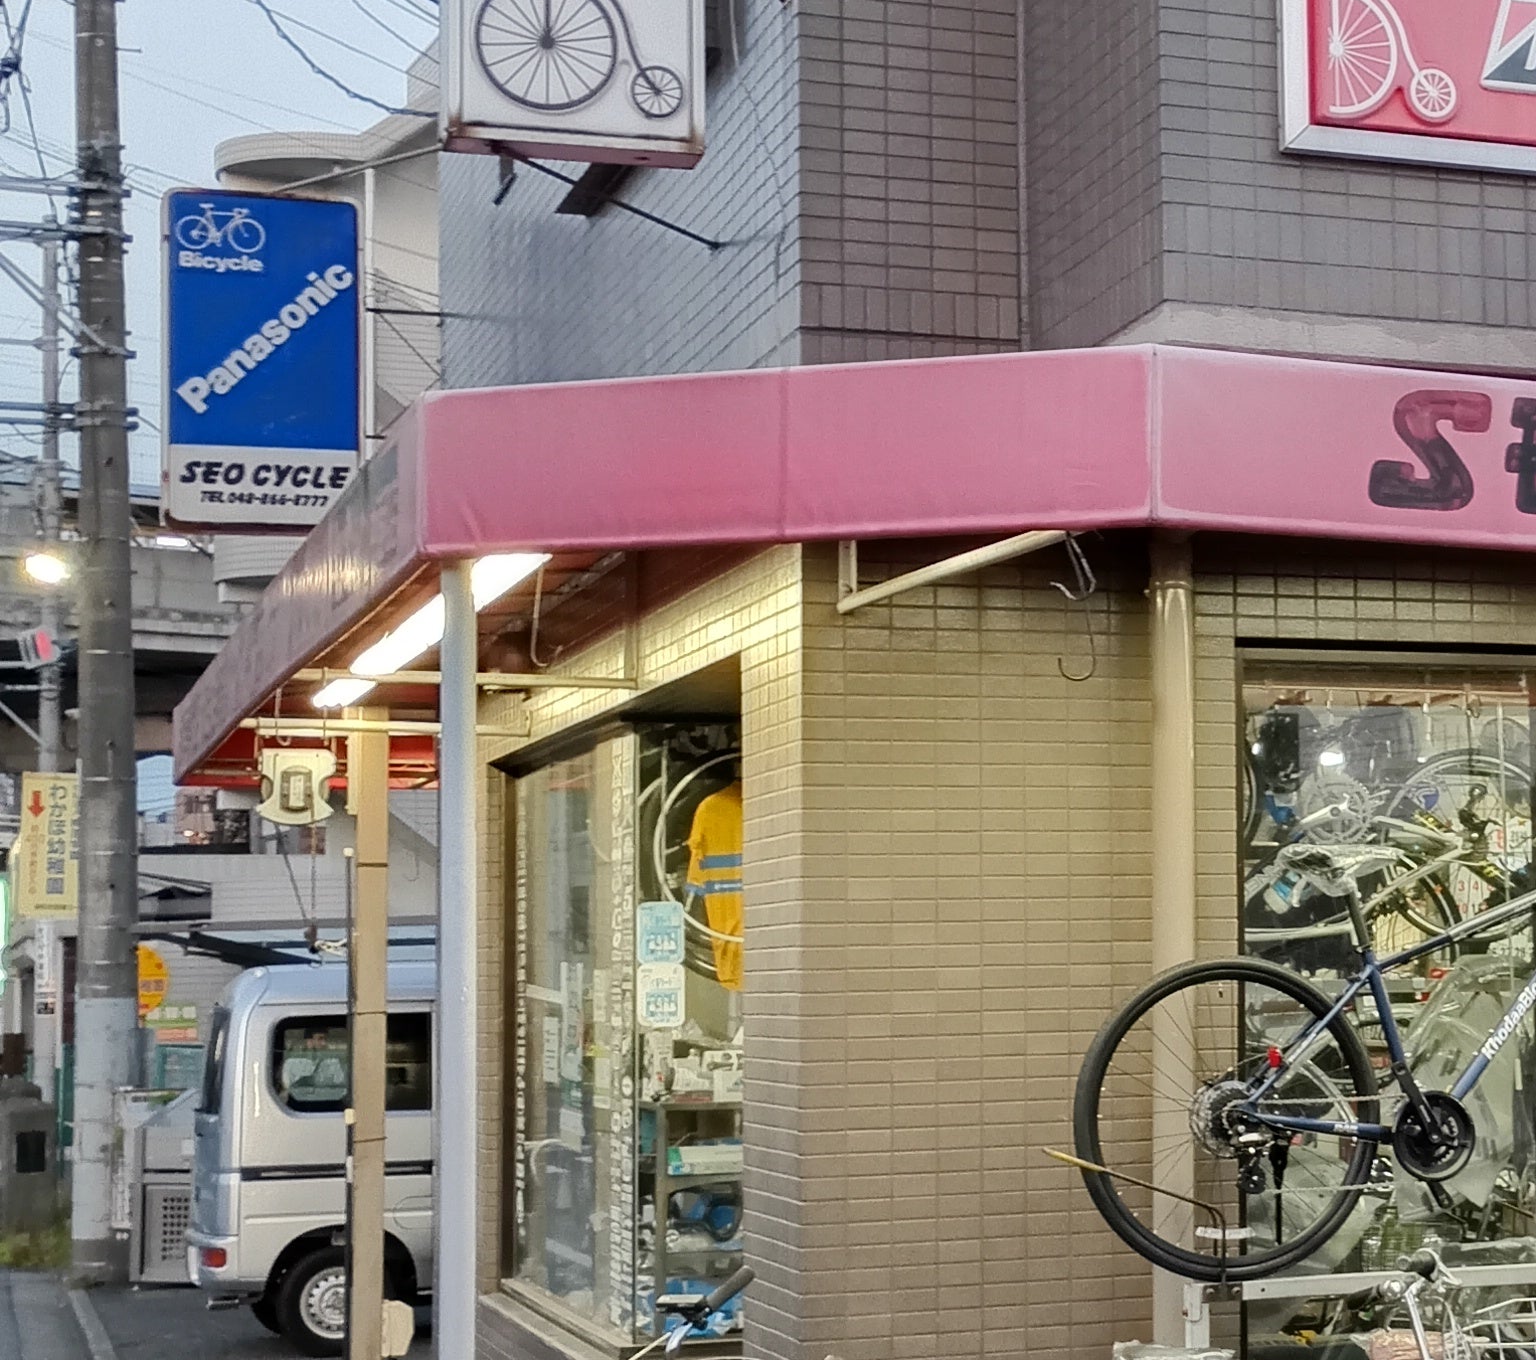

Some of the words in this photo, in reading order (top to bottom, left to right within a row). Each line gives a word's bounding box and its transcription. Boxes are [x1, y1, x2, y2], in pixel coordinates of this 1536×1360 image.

[178, 249, 264, 273] Bicycle
[175, 263, 354, 414] Panasonic
[179, 460, 245, 486] SEO
[252, 463, 351, 489] CYCLE
